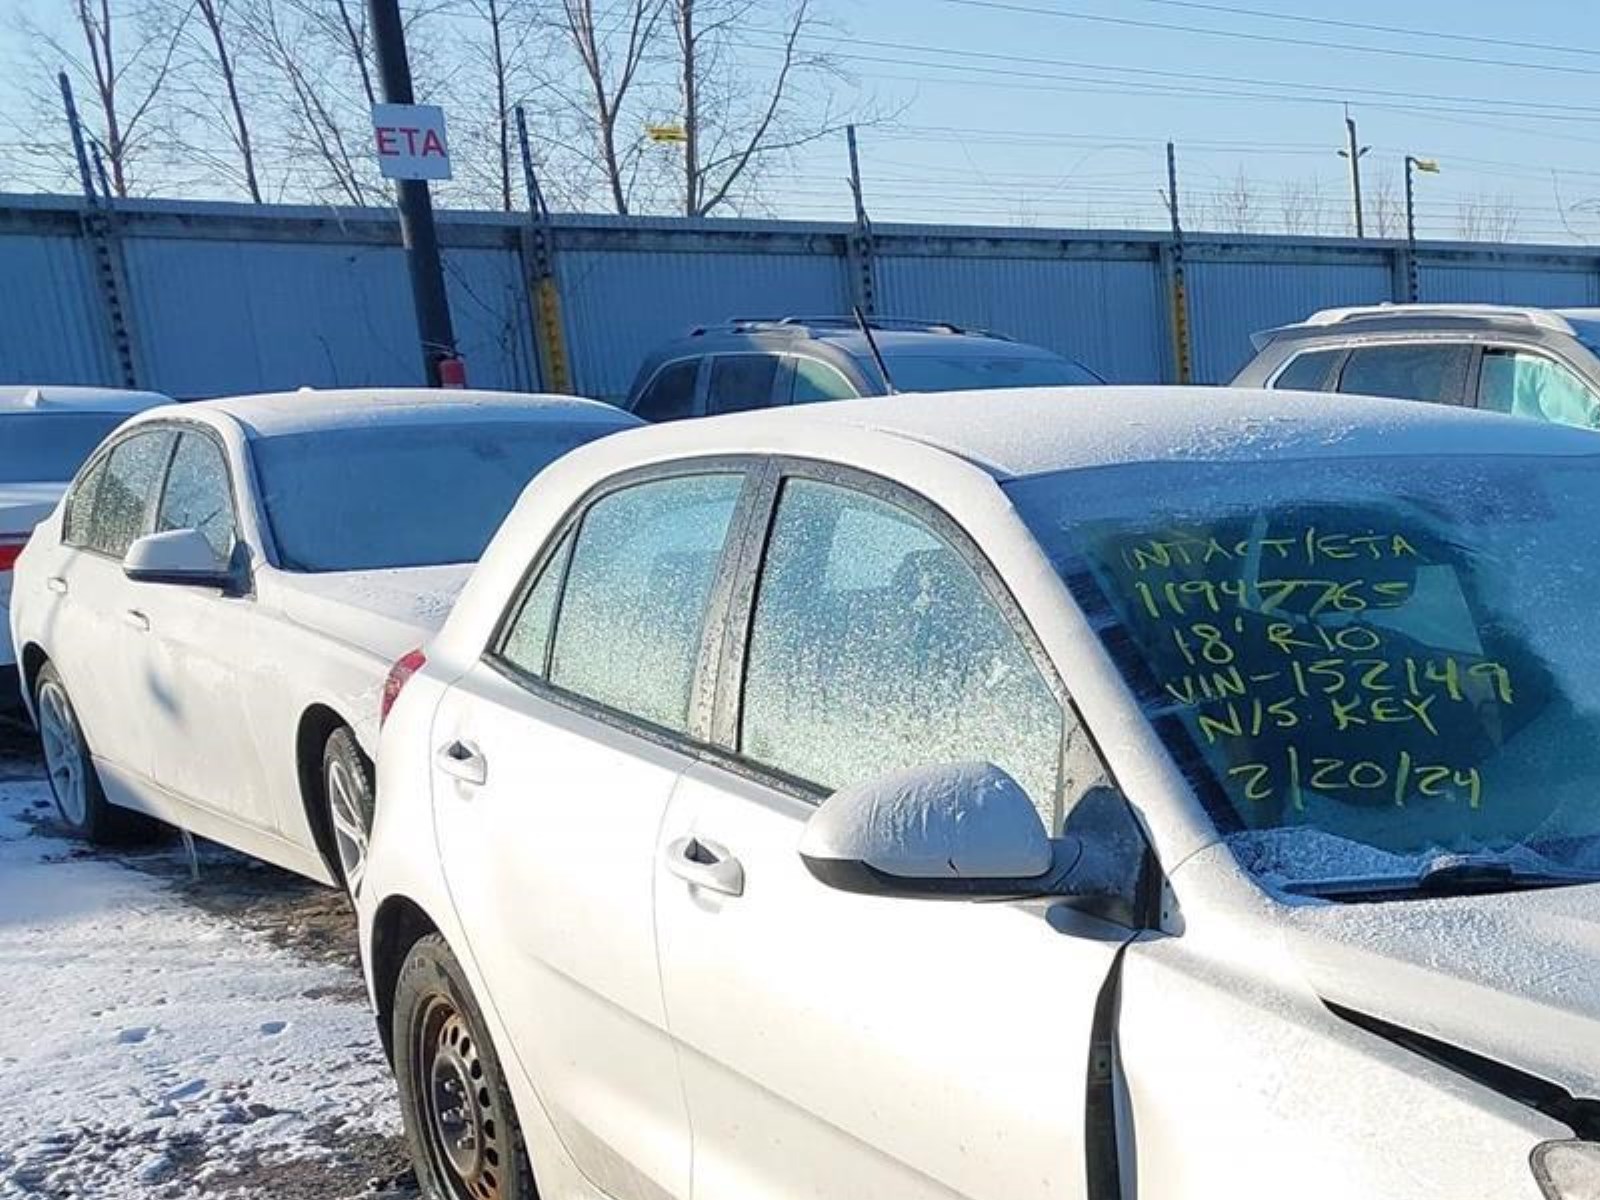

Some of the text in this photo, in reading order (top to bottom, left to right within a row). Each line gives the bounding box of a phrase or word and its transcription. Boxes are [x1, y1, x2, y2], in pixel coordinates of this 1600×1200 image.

[375, 127, 447, 157] ETA
[1267, 622, 1380, 654] RIO
[1332, 695, 1440, 737] KEY
[1229, 746, 1482, 810] 2/20/24
